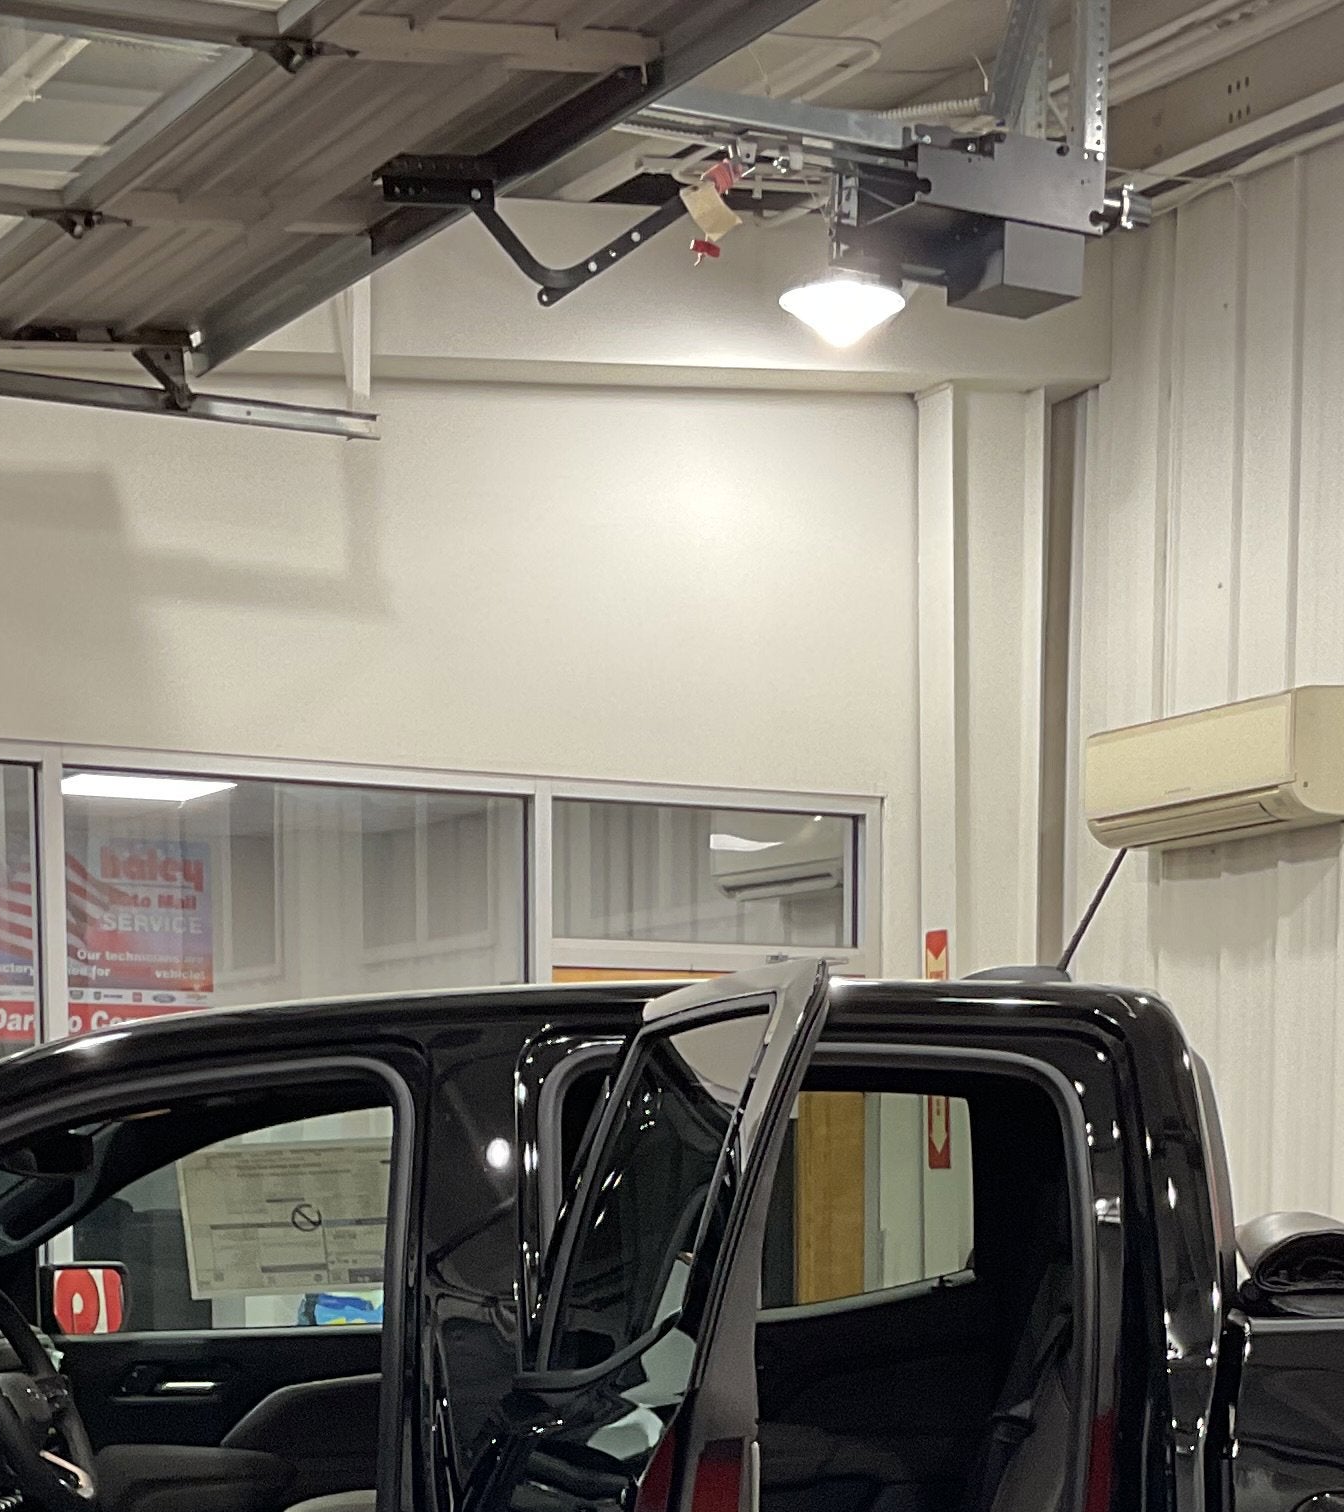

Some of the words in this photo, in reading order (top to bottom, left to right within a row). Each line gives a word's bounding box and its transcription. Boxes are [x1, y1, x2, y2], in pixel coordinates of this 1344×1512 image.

[99, 847, 205, 893] haley
[103, 912, 204, 934] SERVICE
[76, 949, 101, 961] Our
[105, 950, 180, 963] technicians
